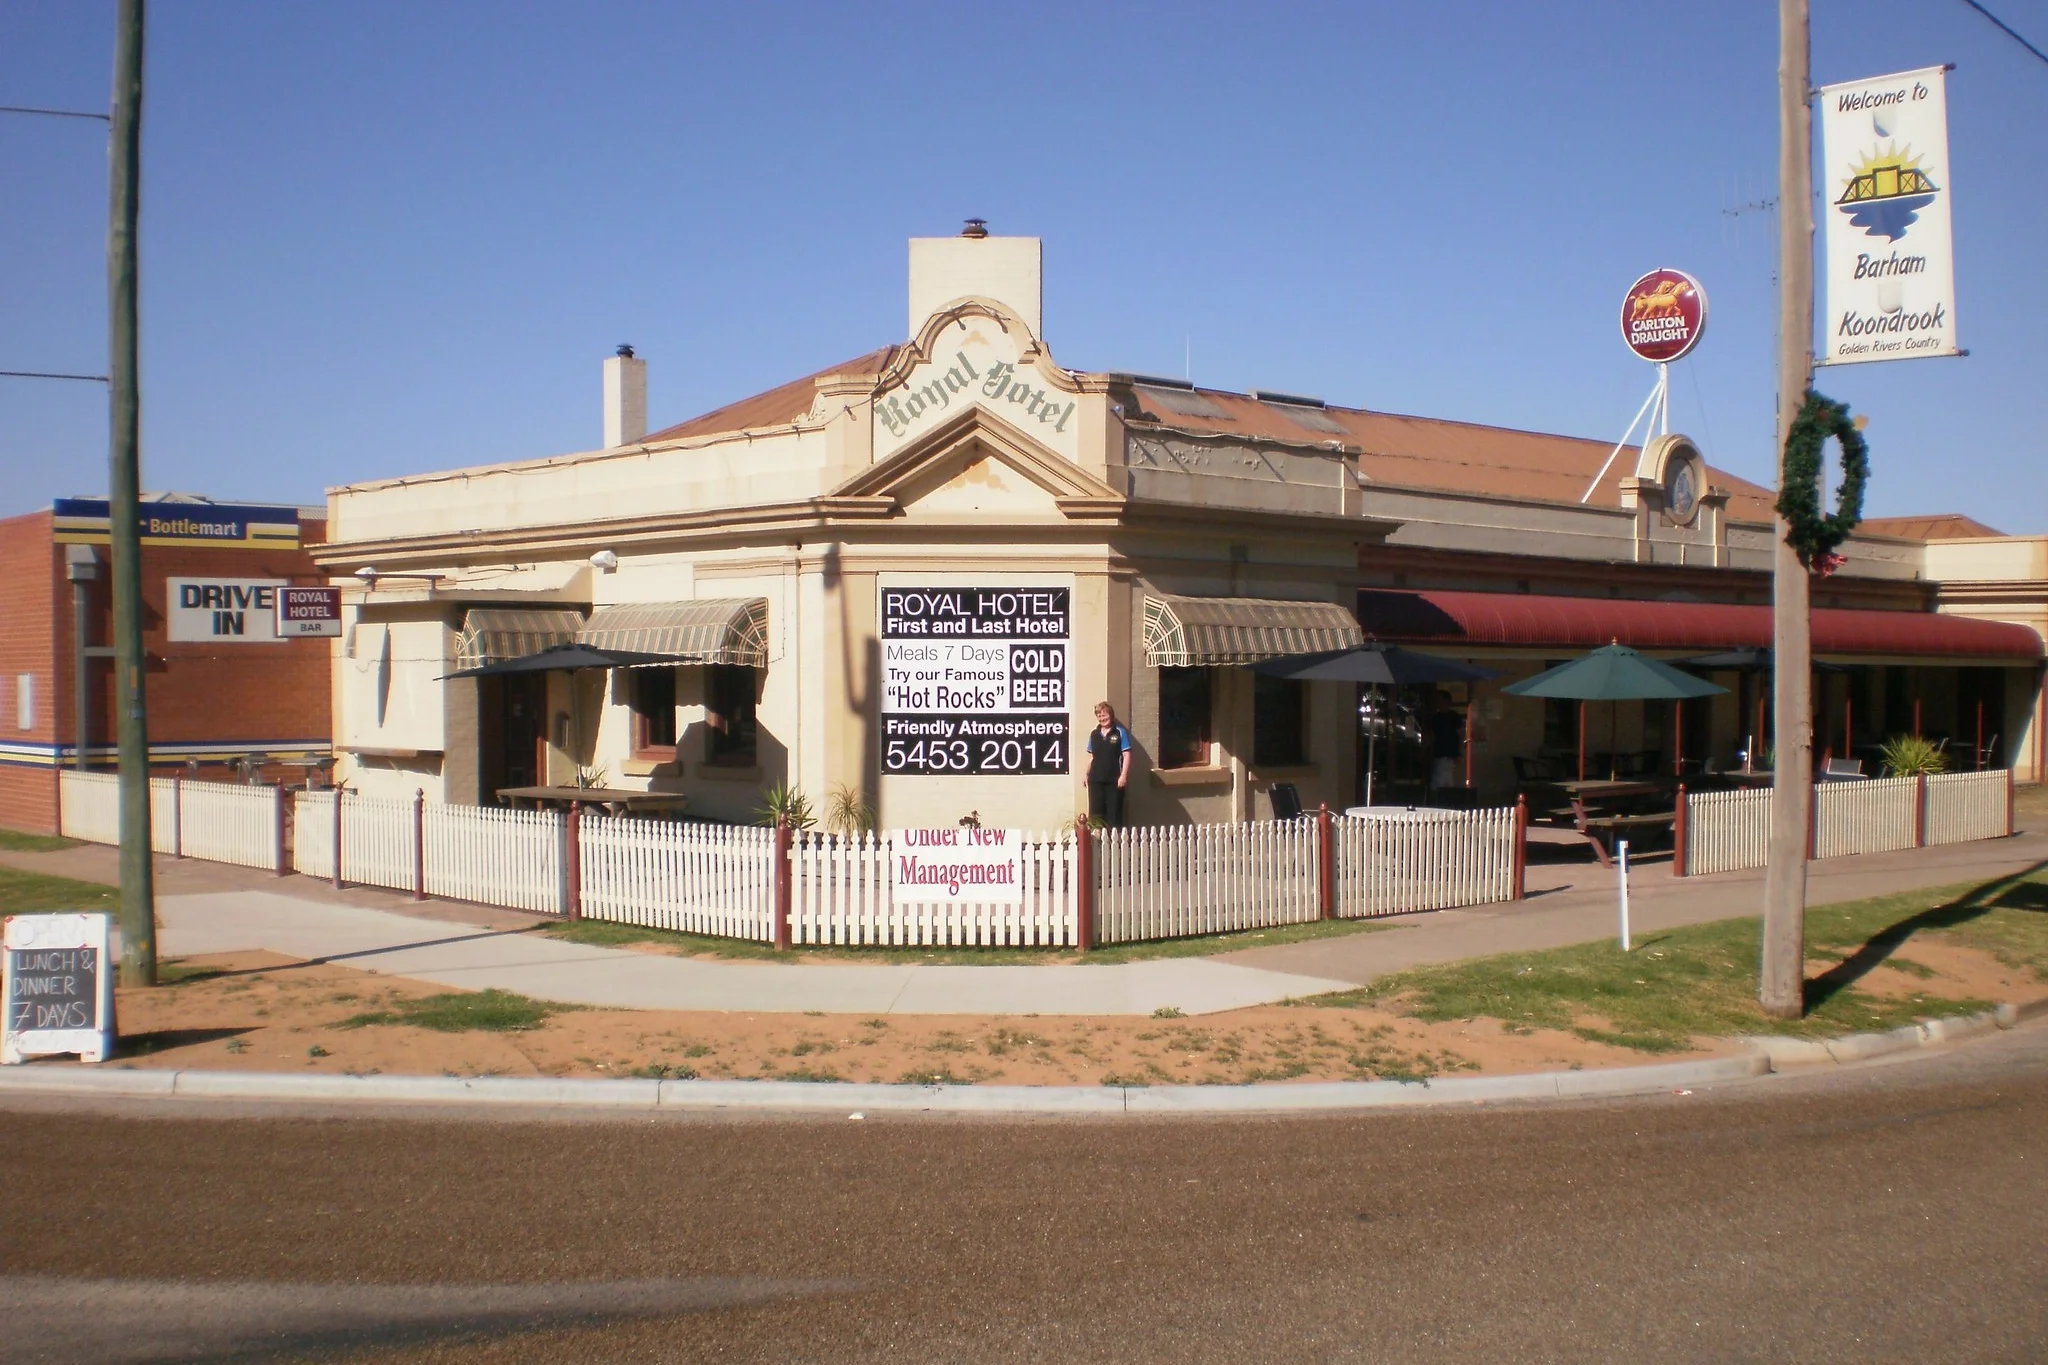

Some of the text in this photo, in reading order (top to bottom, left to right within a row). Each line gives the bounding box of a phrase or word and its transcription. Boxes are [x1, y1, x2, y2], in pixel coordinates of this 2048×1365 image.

[1838, 82, 1928, 112] Welcome to
[1854, 250, 1926, 280] Barham
[1632, 316, 1685, 332] CARLTON
[1838, 302, 1945, 336] Koondrook
[1631, 328, 1689, 345] DRAUGHT
[1839, 336, 1941, 355] Golden Rivers Country
[874, 351, 1076, 437] Royal Hotel
[150, 518, 237, 536] Bottlemart
[180, 584, 273, 609] DRIVE
[289, 592, 331, 603] ROYAL
[887, 593, 1063, 616] ROYAL HOTEL
[289, 606, 331, 617] HOTEL
[213, 611, 244, 635] IN
[300, 623, 322, 632] BAR
[887, 618, 1064, 634] First and Last Hotel
[887, 645, 1005, 665] Meals 7 Days
[1011, 649, 1063, 673] COLD
[888, 668, 1005, 684] Try our Famous
[888, 686, 1005, 708] “Hot Rocks”
[1013, 679, 1062, 702] BEER
[887, 720, 1063, 737] Friendly Atmosphere
[886, 741, 1063, 770] 5453 2014
[967, 829, 1006, 847] New
[899, 855, 1014, 896] Management
[16, 949, 95, 974] LUNCH &
[13, 975, 76, 996] DINNER
[12, 1001, 87, 1028] 7 DAYS
